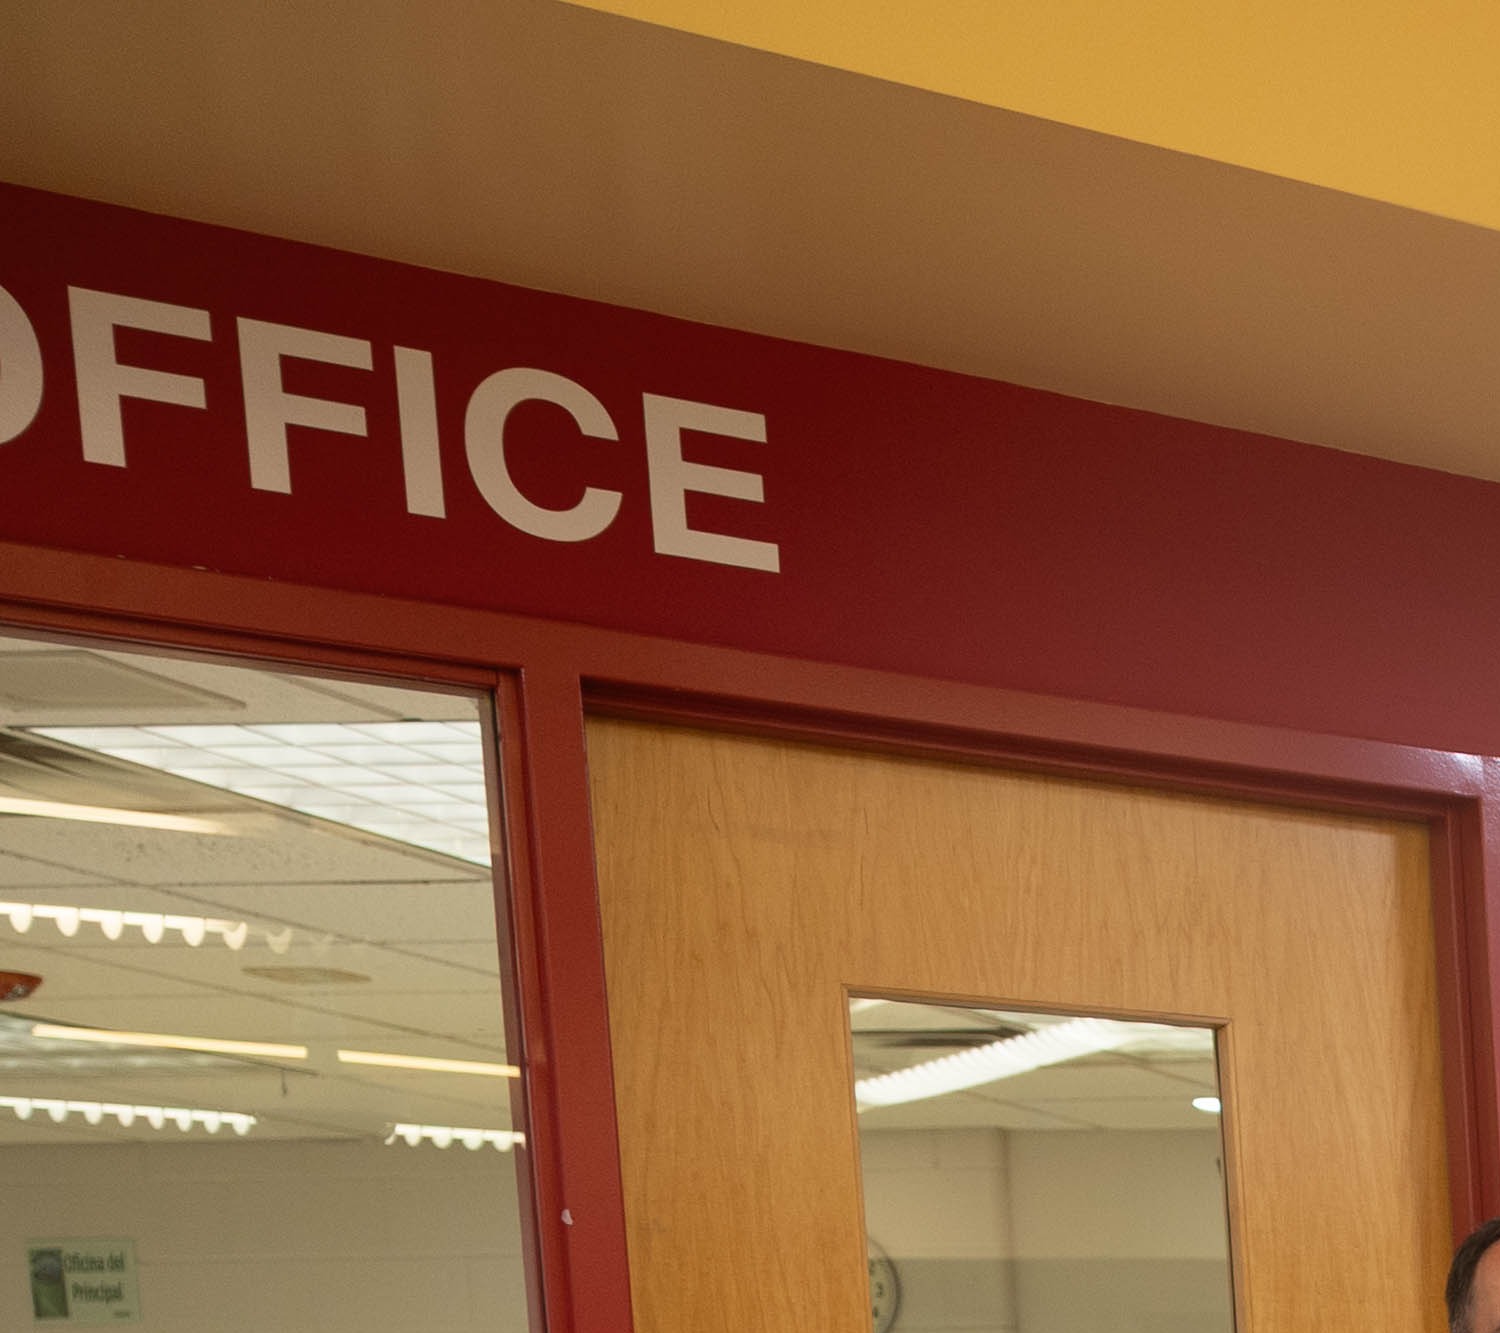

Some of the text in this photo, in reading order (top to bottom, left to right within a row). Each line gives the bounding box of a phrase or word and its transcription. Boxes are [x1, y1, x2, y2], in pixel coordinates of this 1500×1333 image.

[0, 284, 781, 573] FFICE
[64, 1251, 104, 1272] Oficina
[71, 1282, 125, 1304] Principal
